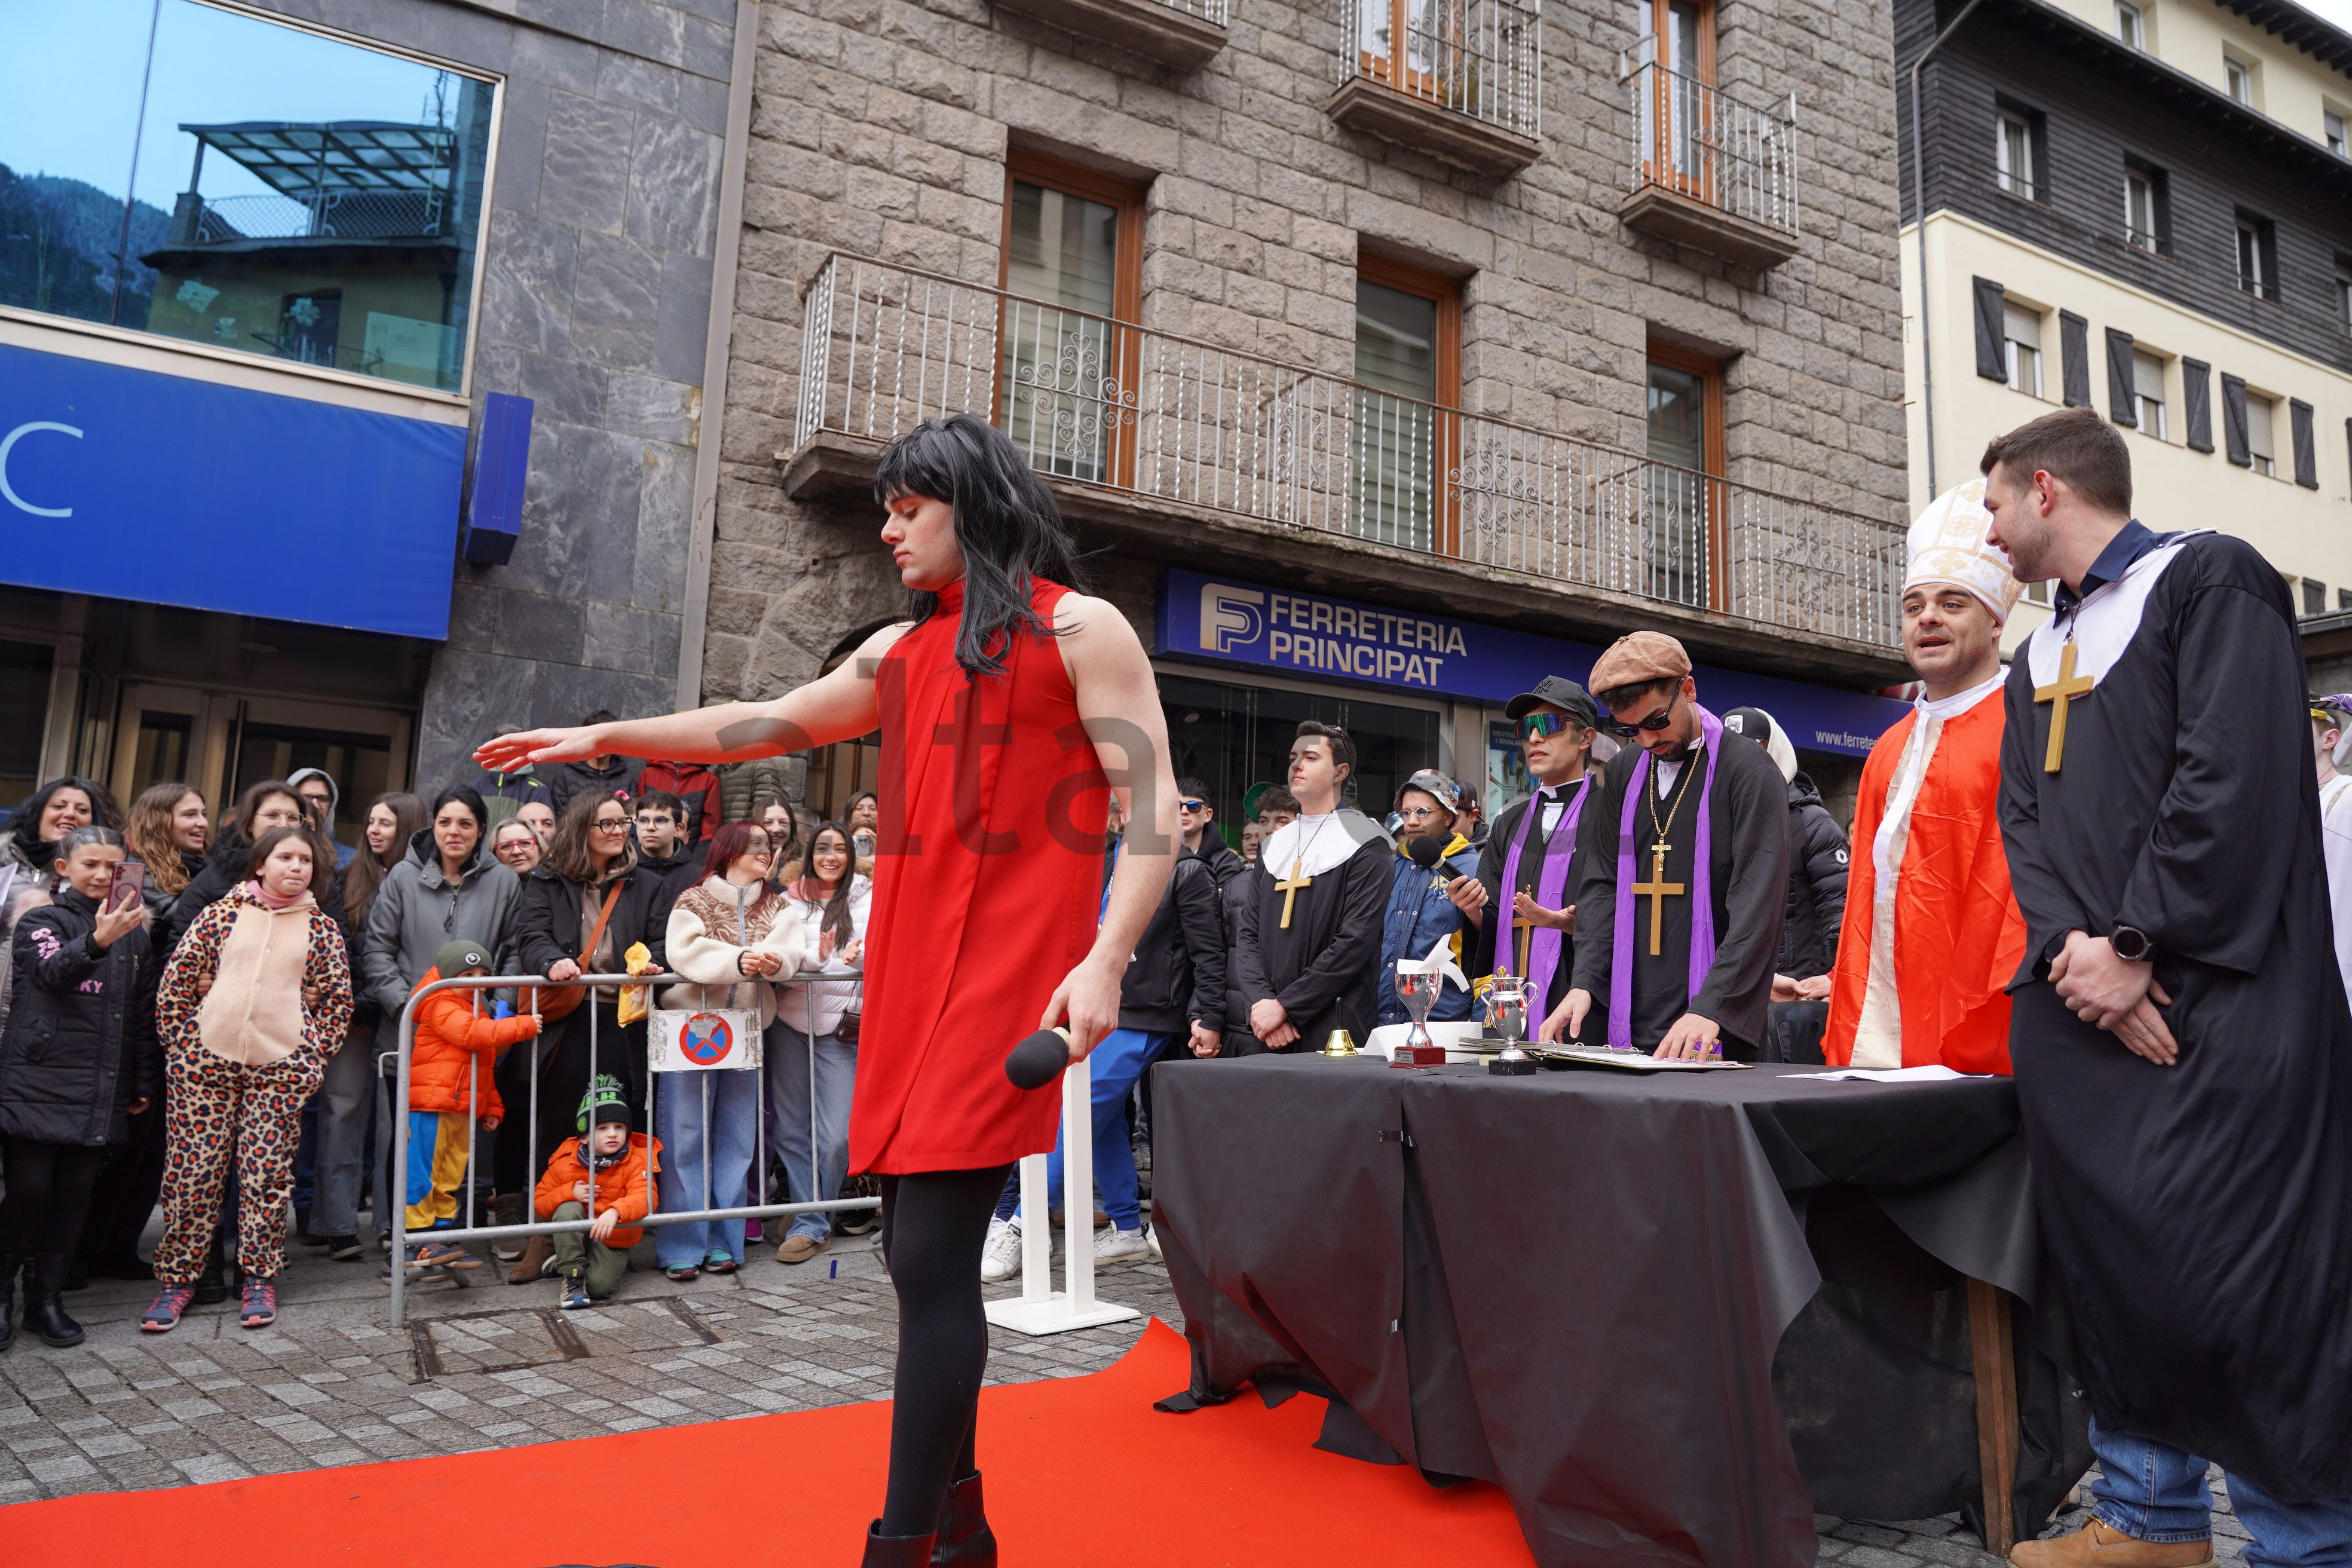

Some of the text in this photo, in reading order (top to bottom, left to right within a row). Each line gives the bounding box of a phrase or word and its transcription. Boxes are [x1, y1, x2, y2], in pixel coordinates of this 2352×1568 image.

[1270, 594, 1467, 657] FERRETERIA
[1270, 630, 1443, 686] PRINCIPAT
[1493, 730, 1517, 739] MESTRE
